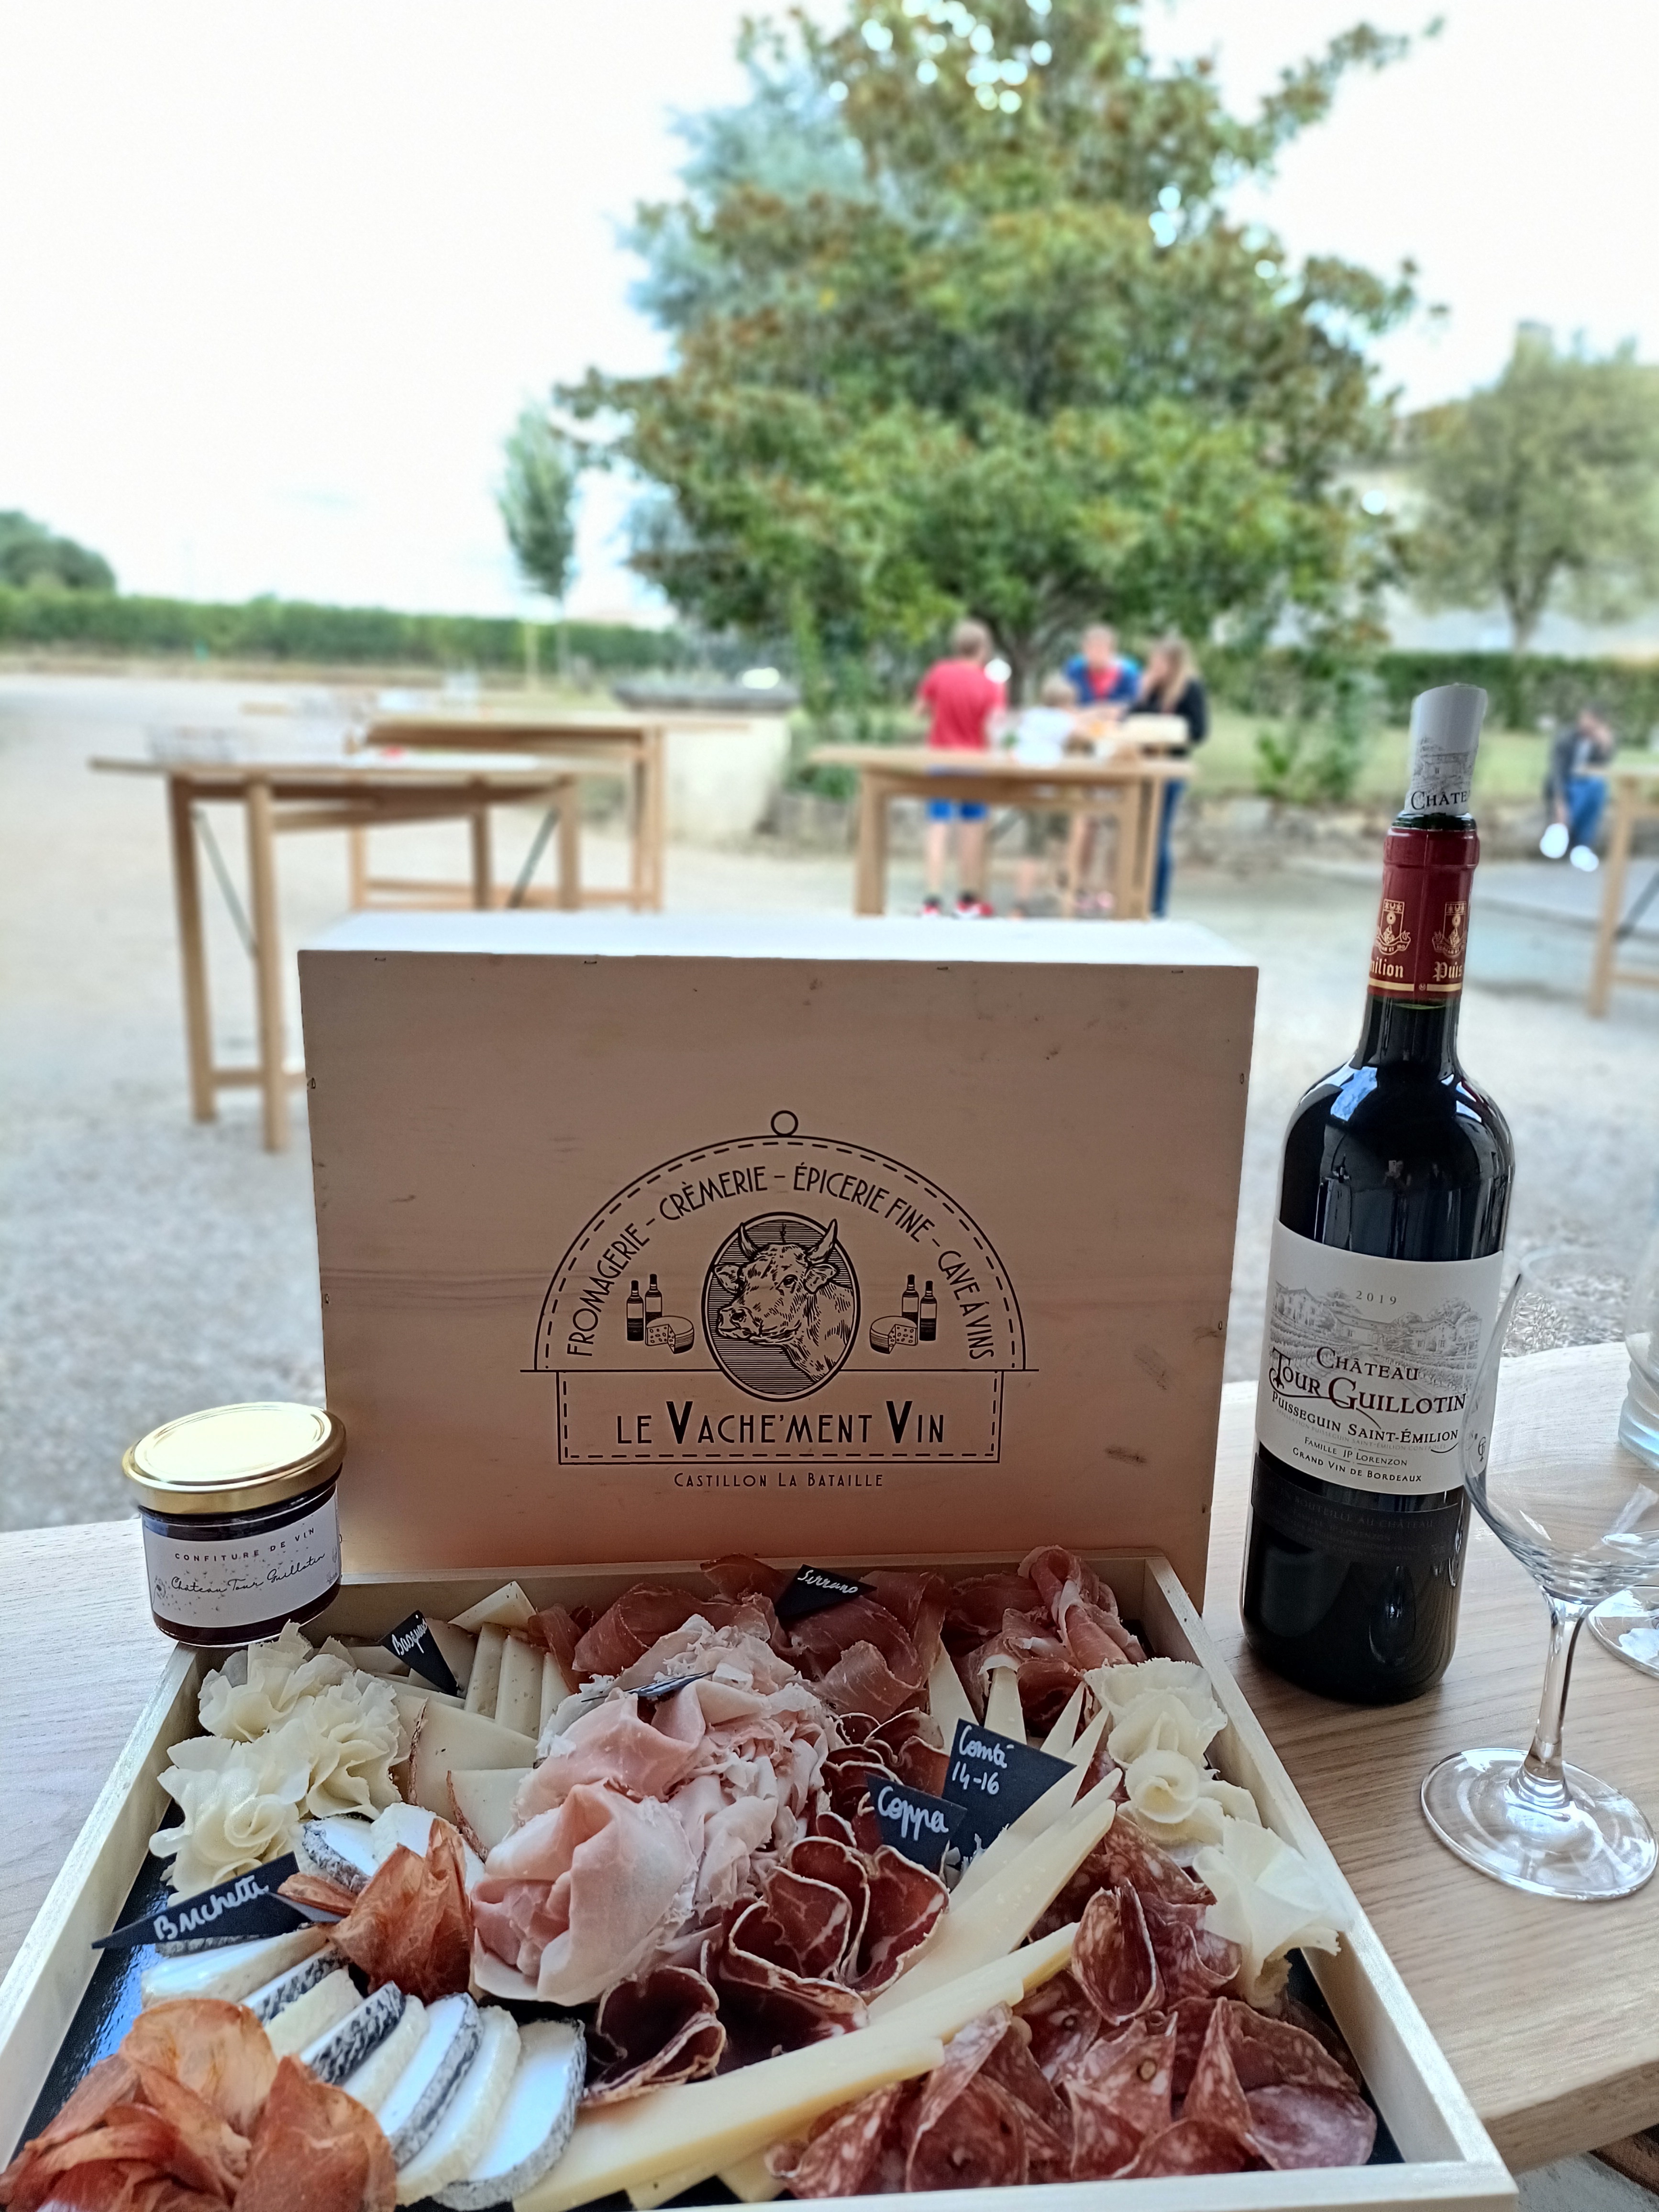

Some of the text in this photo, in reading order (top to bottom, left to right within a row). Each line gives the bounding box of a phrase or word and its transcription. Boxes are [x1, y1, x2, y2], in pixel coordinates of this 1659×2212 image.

[1411, 791, 1471, 810] CHÂTE
[567, 1223, 650, 1356] FROMAGERIE
[660, 1166, 768, 1220] CRÈMERIE
[794, 1162, 890, 1213] ÉPICERIE
[885, 1197, 935, 1242] FINE
[938, 1250, 980, 1301] CAVE
[965, 1315, 995, 1360] VINS
[1356, 1290, 1397, 1305] 2019
[1269, 1346, 1467, 1414] TOUR GUILLOTIN
[617, 1415, 652, 1444] LE
[885, 1400, 944, 1444] VIN
[1272, 1390, 1459, 1444] PUISSEGUIN SAINT-ÉMILION
[1293, 1447, 1422, 1482] GRAND VIN DE BORDEAUX
[1304, 1437, 1408, 1466] FAMILLE JP LORENZON
[674, 1472, 883, 1487] CASTILLON LA BATAILLE
[175, 1528, 315, 1561] CONFITURE DE VIN
[171, 1553, 325, 1593] Château Tour Guillotin
[797, 1570, 858, 1593] Serrano
[951, 1761, 1000, 1795] 14-16
[878, 1786, 949, 1841] Coppa
